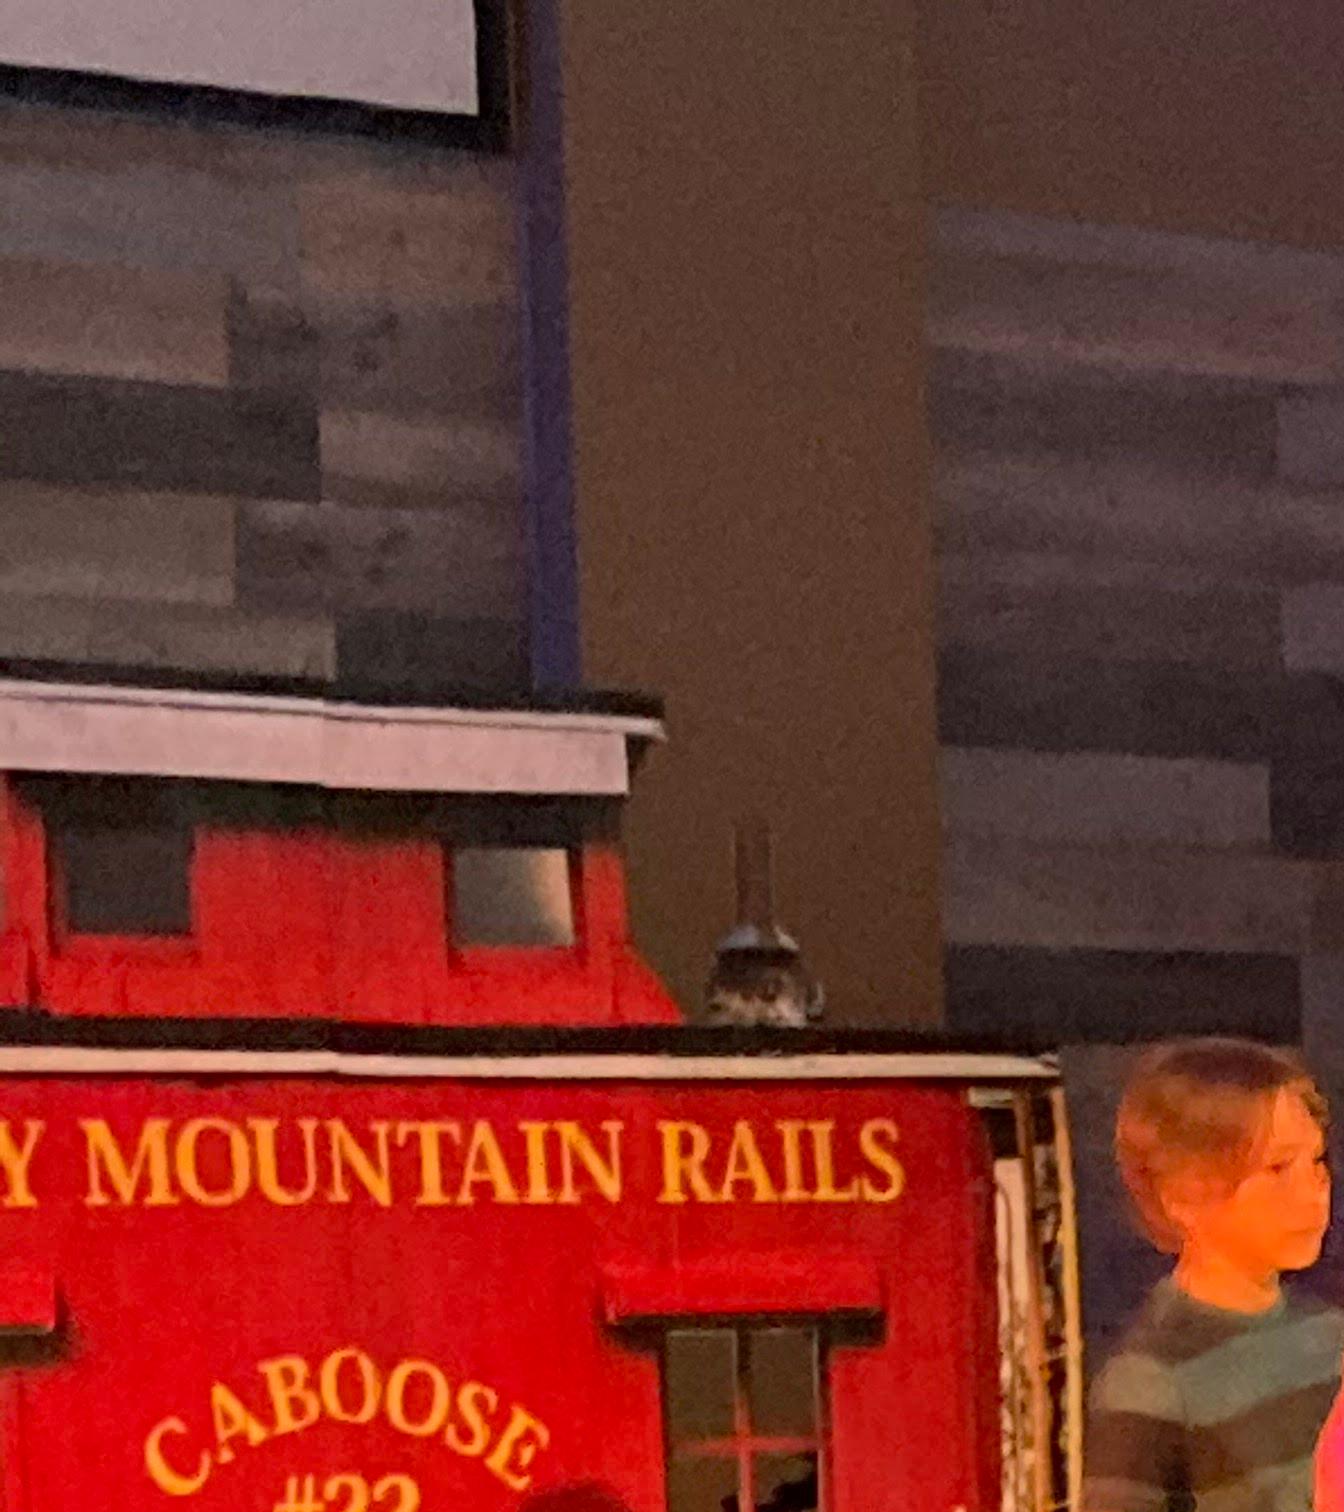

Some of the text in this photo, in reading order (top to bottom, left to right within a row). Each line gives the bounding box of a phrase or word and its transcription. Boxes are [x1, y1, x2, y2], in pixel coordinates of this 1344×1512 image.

[78, 1117, 624, 1206] MOUNTAIN
[656, 1117, 906, 1204] RAILS
[143, 1346, 551, 1497] CABOOSE
